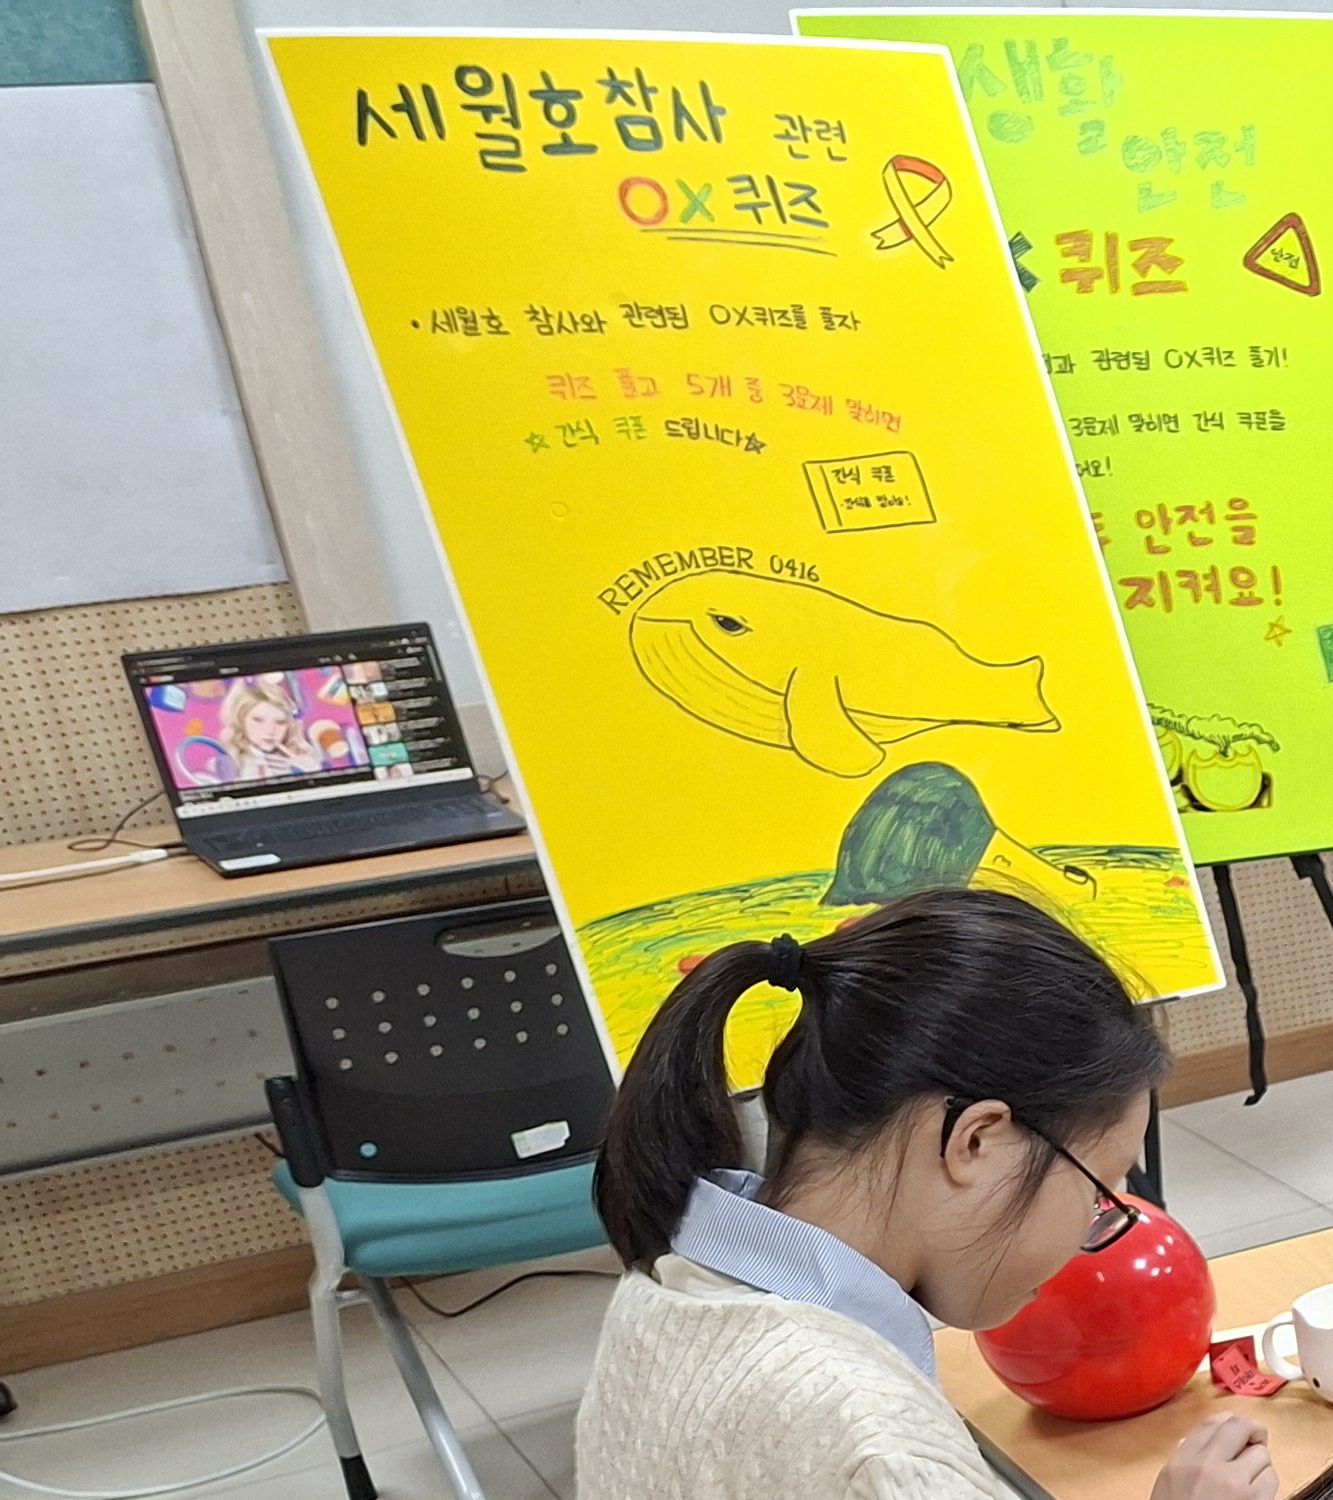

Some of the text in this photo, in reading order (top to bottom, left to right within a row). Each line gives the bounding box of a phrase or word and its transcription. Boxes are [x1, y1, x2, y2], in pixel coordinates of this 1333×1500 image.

[773, 114, 848, 161] 관련
[1121, 123, 1258, 213] 안전
[430, 306, 510, 337] 세월호
[524, 303, 608, 336] 참사와
[619, 301, 689, 330] 관련된
[546, 372, 597, 401] 퀴즈
[686, 373, 732, 399] 5개
[554, 418, 599, 448] 간식
[613, 415, 648, 440] 쿠폰
[1193, 410, 1225, 432] 간식
[1236, 409, 1287, 431] 쿠폰을
[1134, 497, 1259, 555] 안전을
[597, 545, 820, 616] REMEMBER 0416
[1117, 563, 1283, 614] 지켜요!
